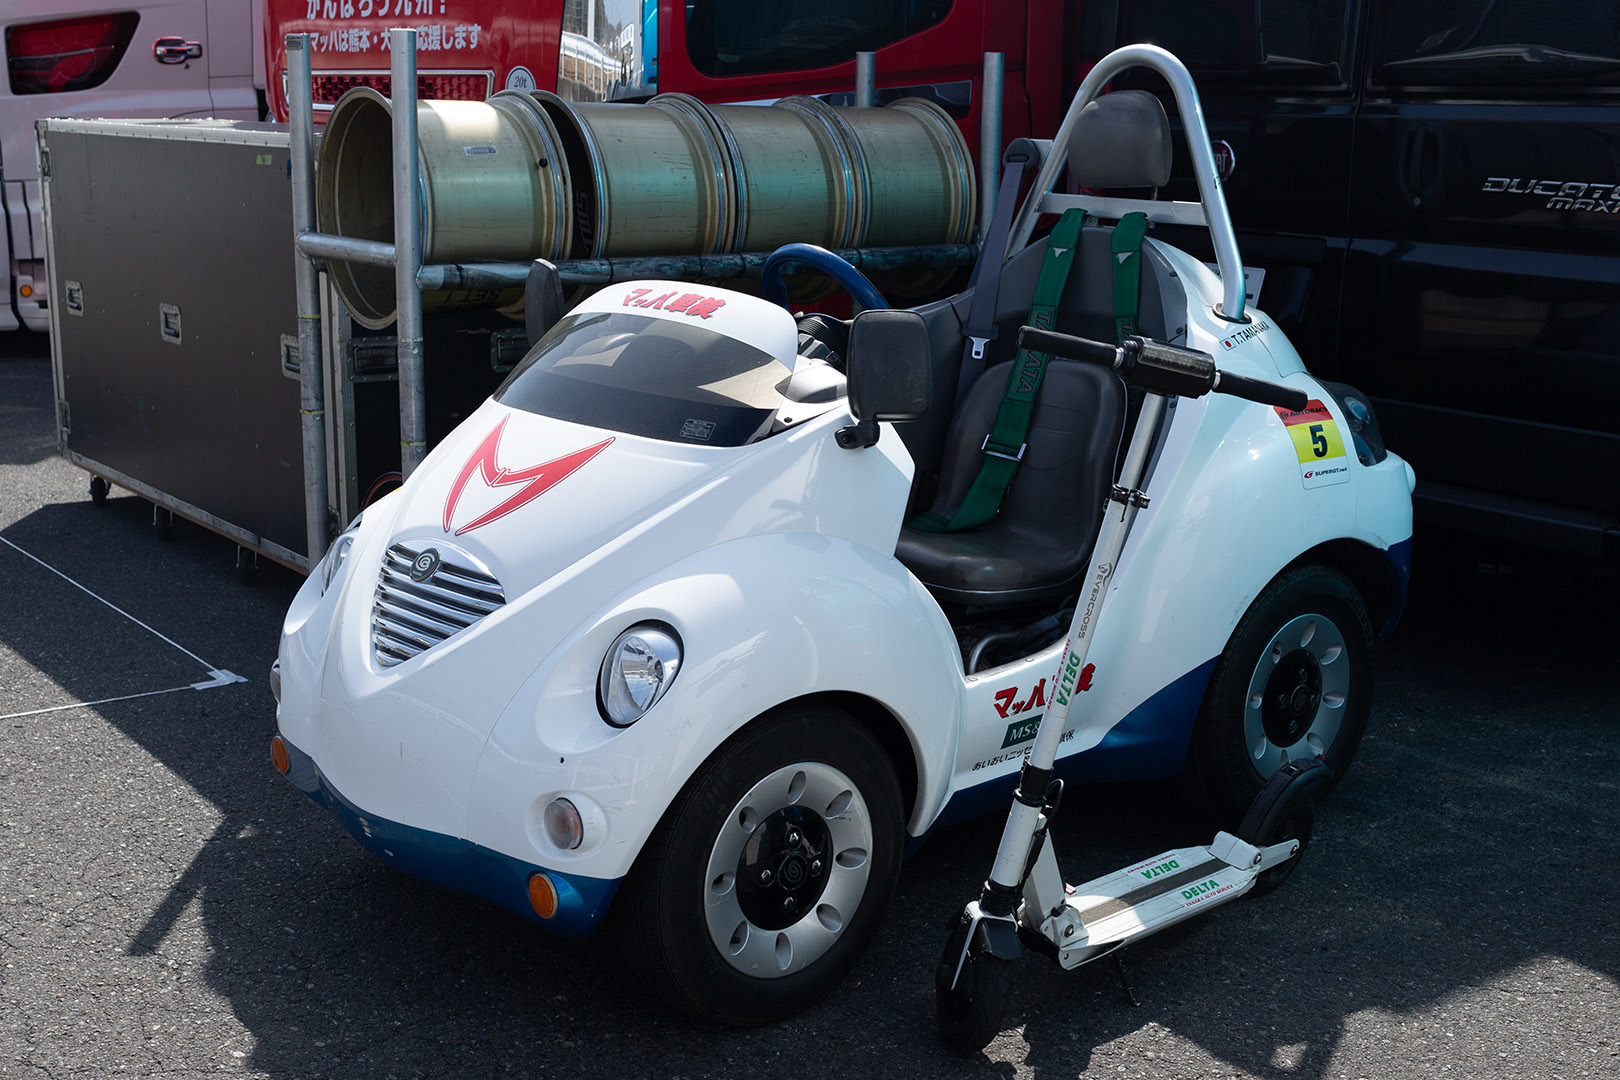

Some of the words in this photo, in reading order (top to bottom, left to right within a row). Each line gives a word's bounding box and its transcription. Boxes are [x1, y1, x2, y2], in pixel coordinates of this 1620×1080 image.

[513, 75, 528, 89] 20t
[1309, 424, 1328, 457] 5
[1077, 573, 1103, 640] EVERCROSS
[1056, 650, 1081, 706] DELTA
[1141, 859, 1180, 880] DELTA
[1181, 879, 1220, 900] DELTA
